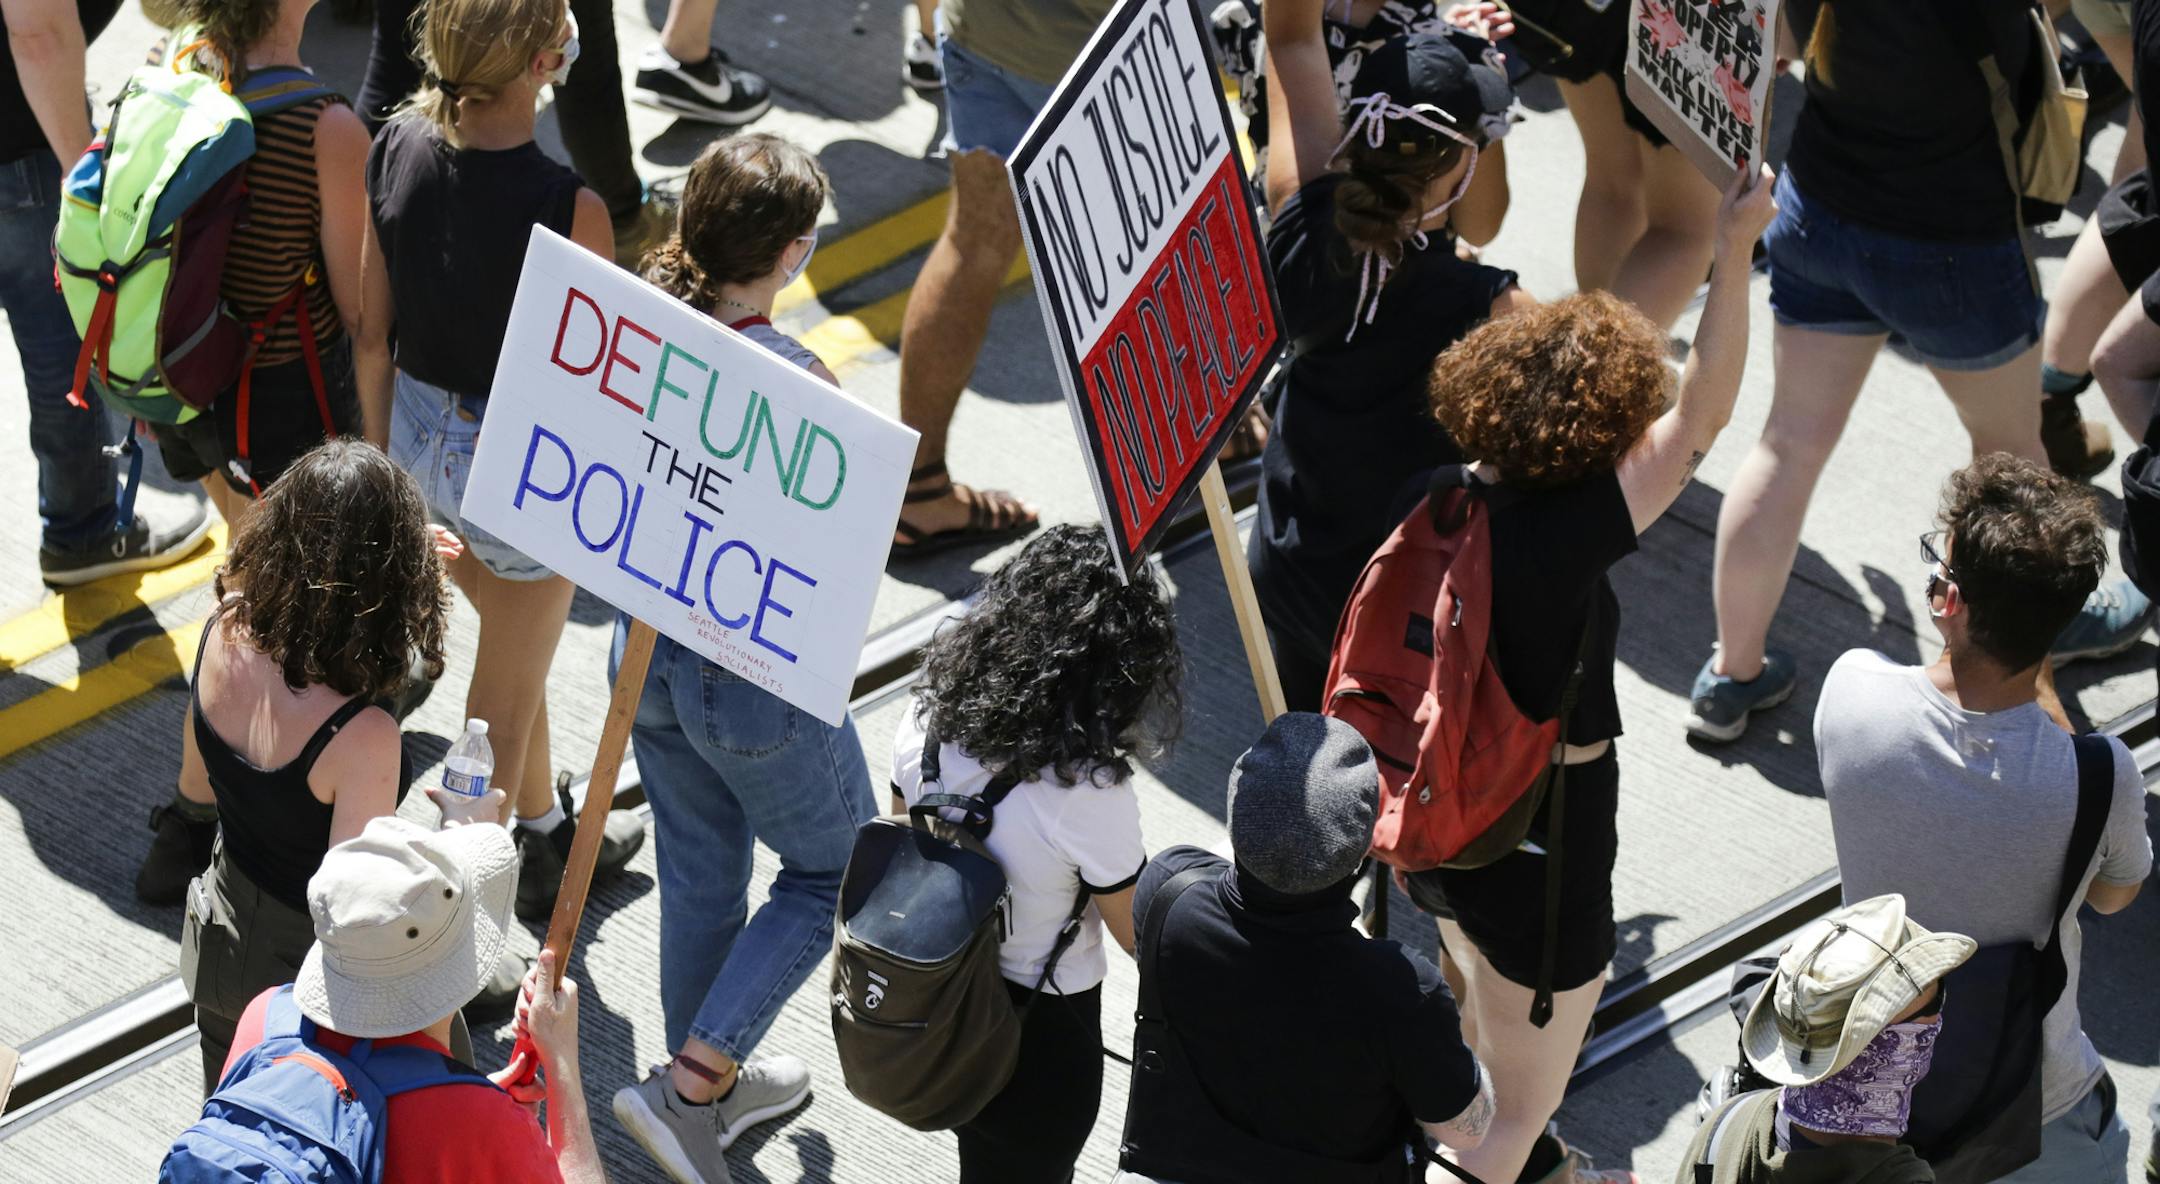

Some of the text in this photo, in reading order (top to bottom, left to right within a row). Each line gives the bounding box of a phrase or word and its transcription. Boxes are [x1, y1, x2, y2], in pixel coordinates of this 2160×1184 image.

[1638, 22, 1754, 150] BLACK LIVES
[1638, 48, 1751, 166] MATTER
[1033, 0, 1220, 342] NO JUSTICE
[551, 287, 847, 511] DEFUND
[1092, 331, 1166, 528] NO
[642, 430, 733, 515] THE
[513, 424, 818, 664] POLICE
[688, 611, 730, 639] SEATTLE
[697, 628, 773, 672] REVOLUTIONARY
[715, 651, 784, 693] SOCIALISTS
